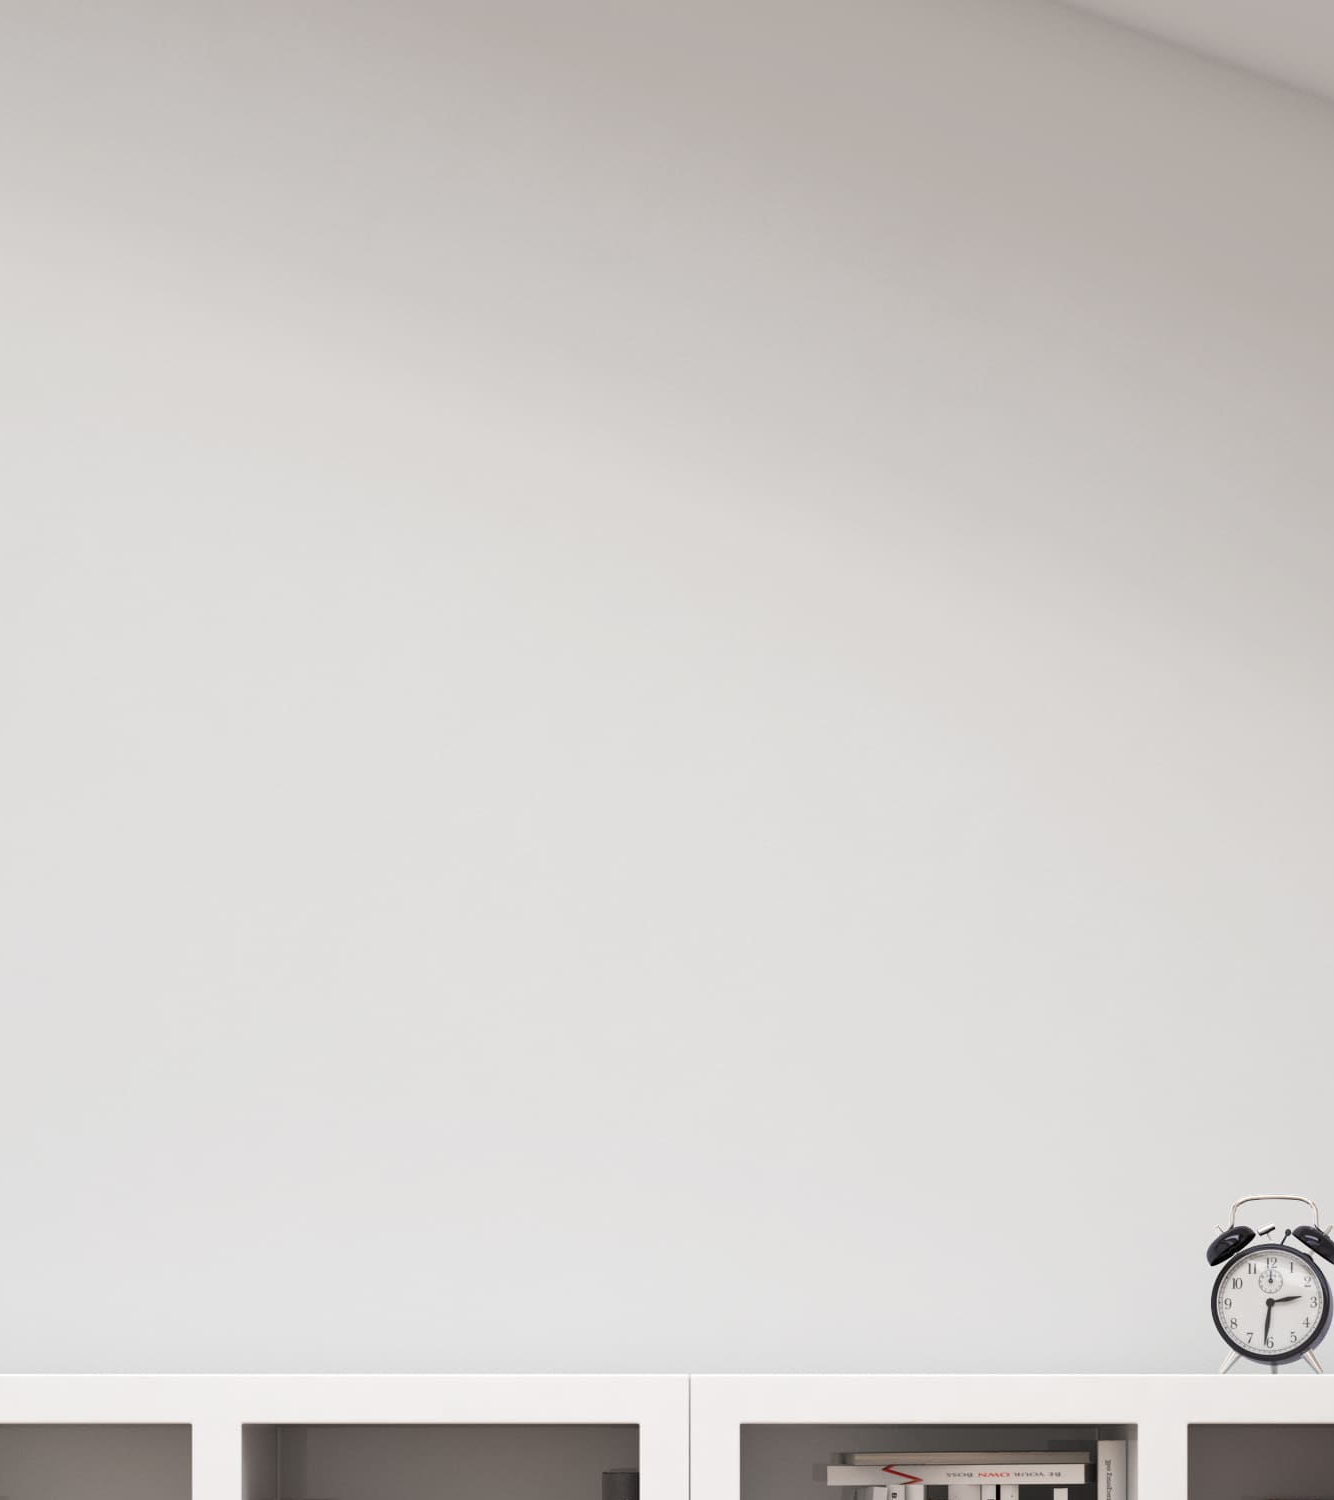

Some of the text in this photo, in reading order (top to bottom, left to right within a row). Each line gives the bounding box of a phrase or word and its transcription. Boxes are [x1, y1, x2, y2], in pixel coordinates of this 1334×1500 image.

[1267, 1257, 1277, 1268] 12
[1248, 1263, 1256, 1274] 11
[1232, 1278, 1243, 1289] 10
[1304, 1276, 1311, 1287] 2
[1224, 1298, 1231, 1309] 9
[1310, 1297, 1317, 1308] 3
[1230, 1318, 1237, 1329] 8
[1302, 1317, 1310, 1328] 4
[1247, 1332, 1254, 1343] 7
[1267, 1337, 1274, 1348] 6
[1290, 1331, 1297, 1343] 5
